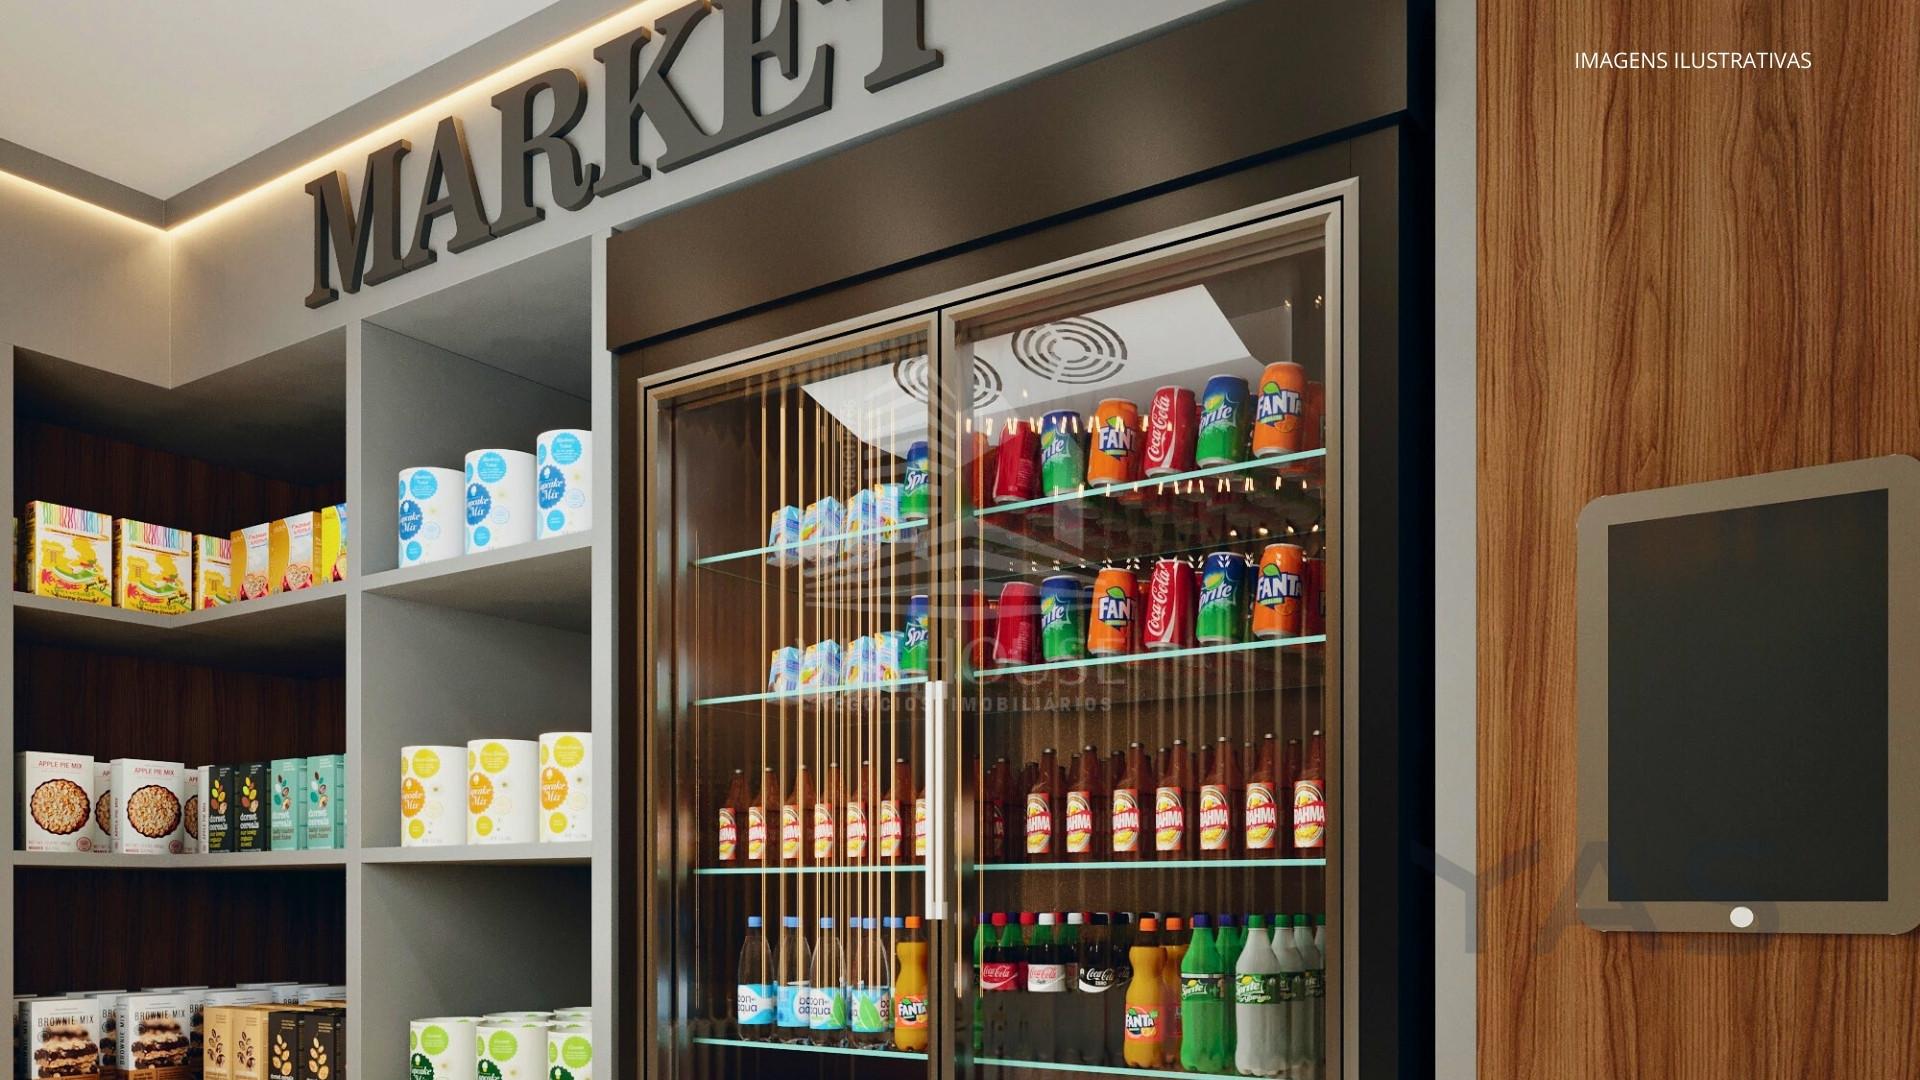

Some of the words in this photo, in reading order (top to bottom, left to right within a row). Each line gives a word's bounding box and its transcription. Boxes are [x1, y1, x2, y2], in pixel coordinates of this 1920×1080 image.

[305, 0, 944, 309] MARKET
[38, 760, 59, 768] APPLE
[134, 1010, 169, 1020] BROWNIE
[172, 1009, 185, 1018] MIX
[38, 1016, 75, 1027] BROWNIE
[80, 1015, 94, 1024] MIX
